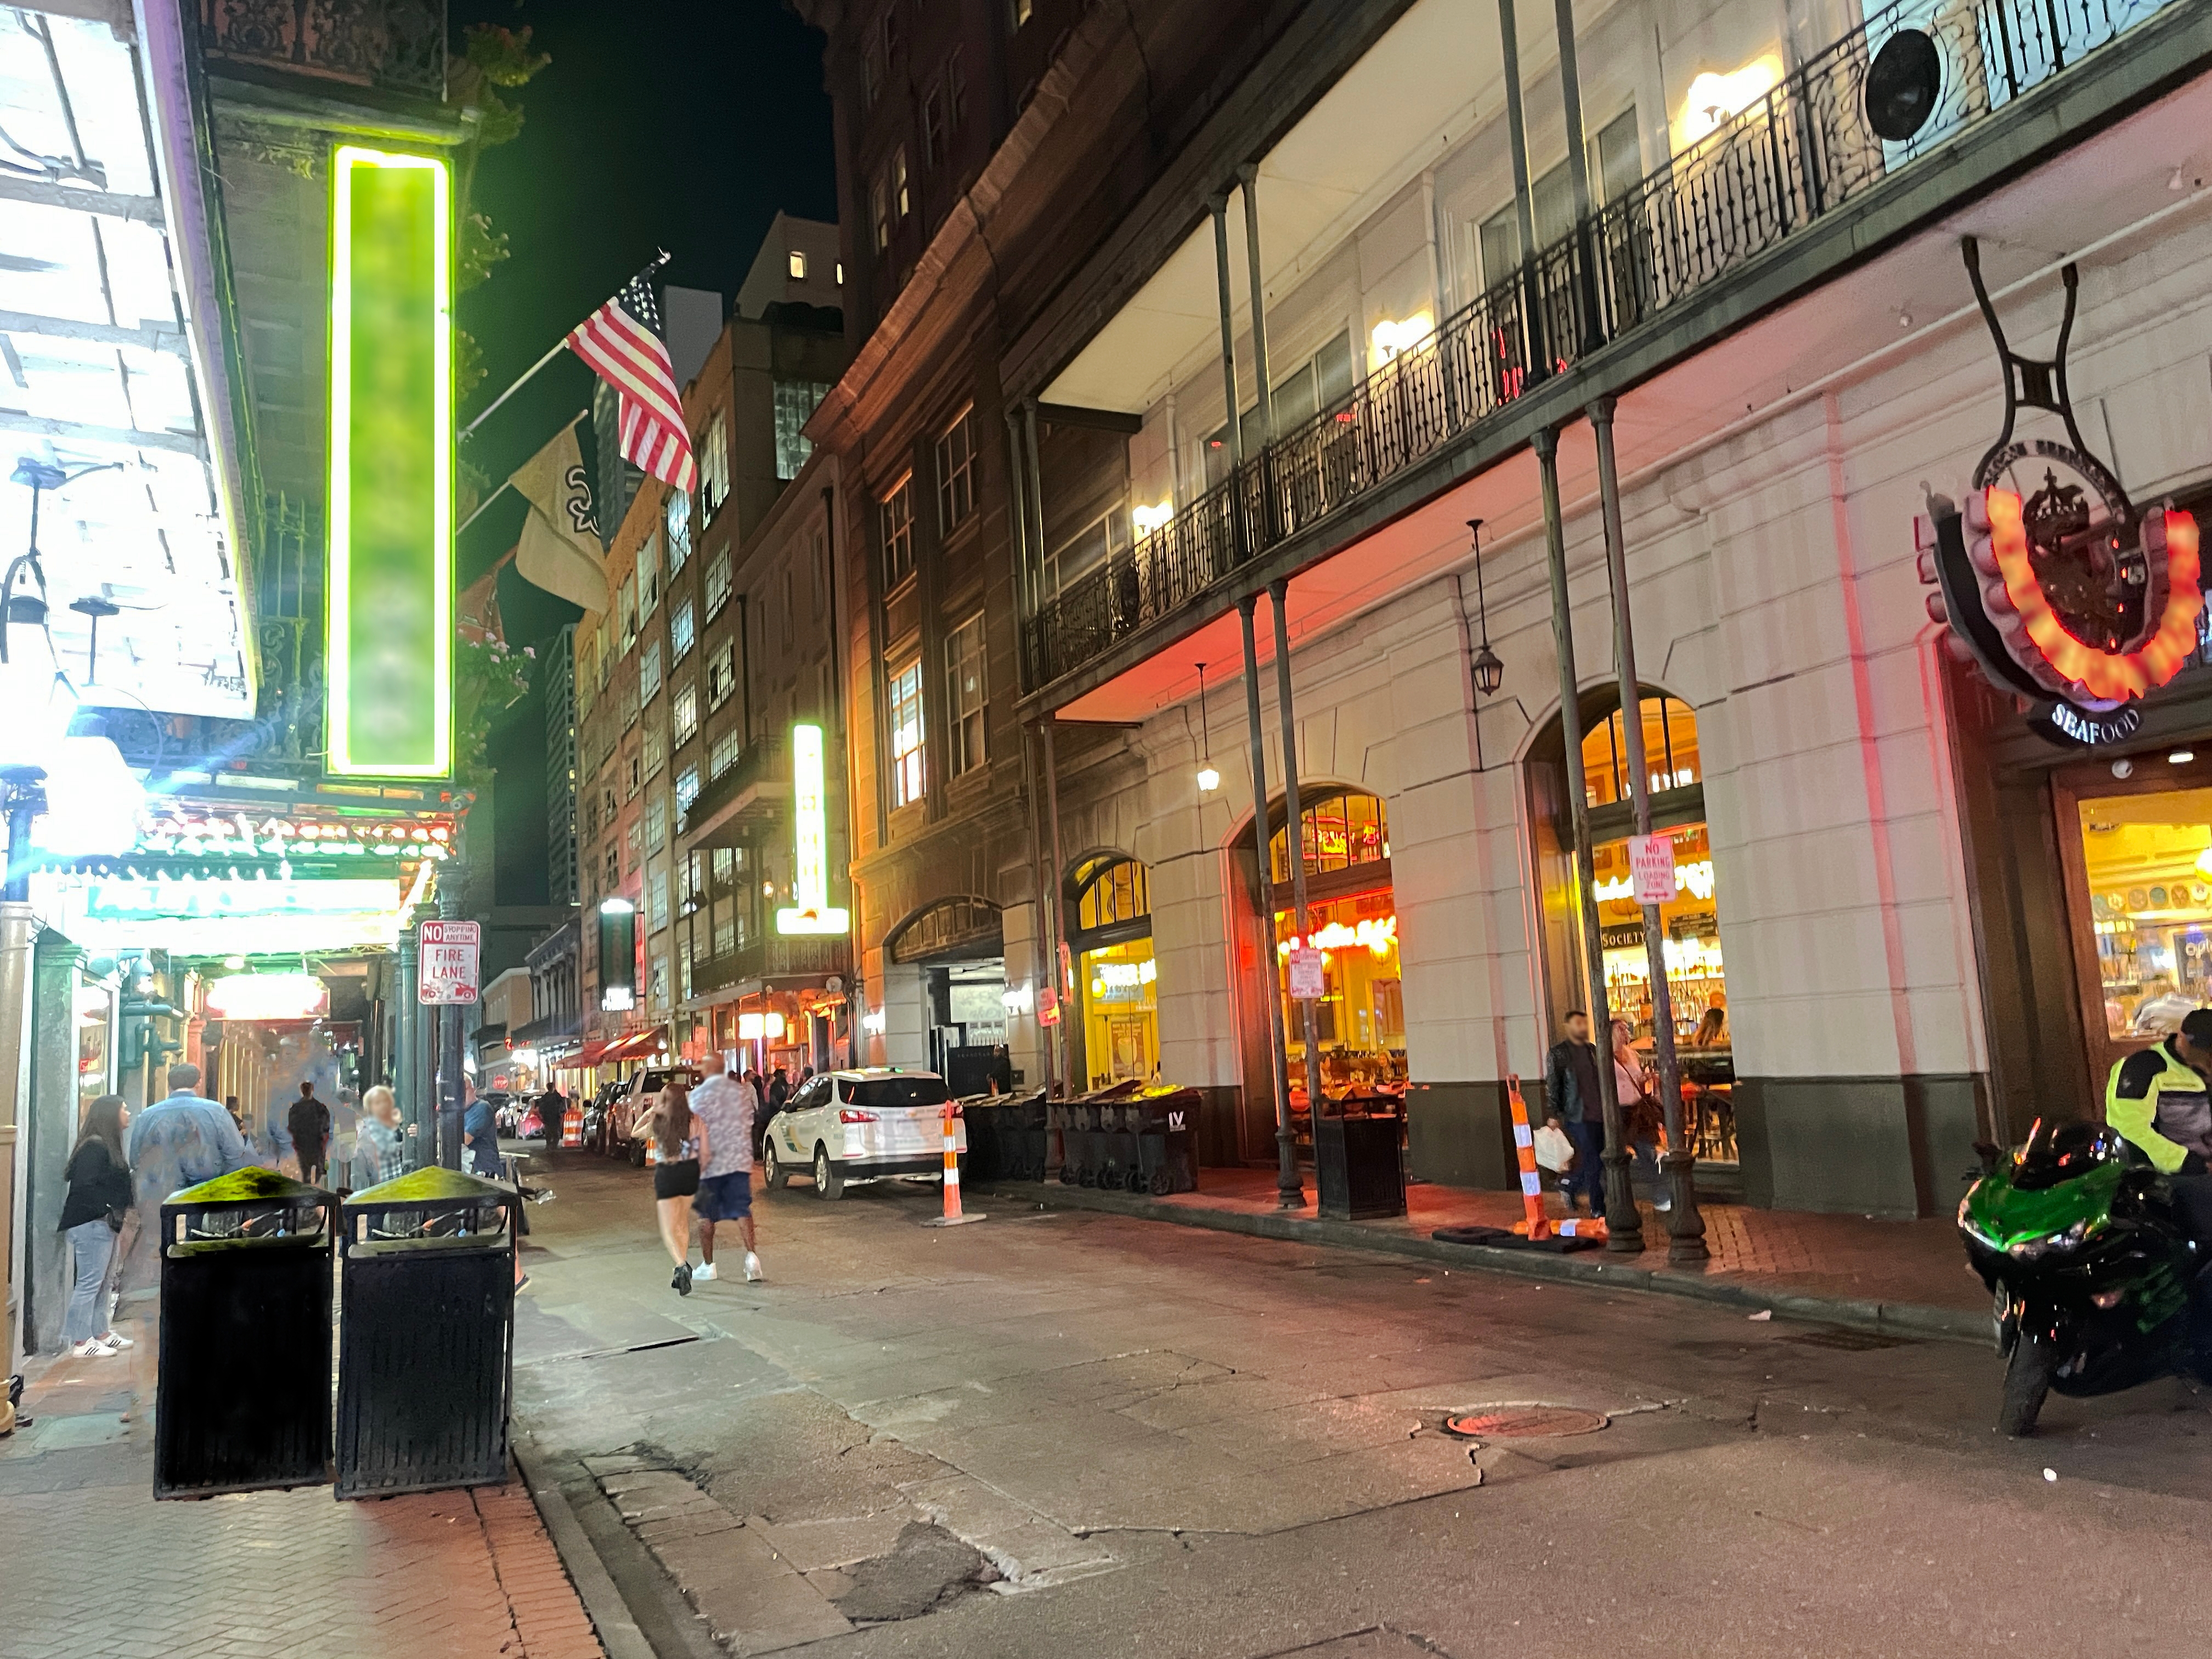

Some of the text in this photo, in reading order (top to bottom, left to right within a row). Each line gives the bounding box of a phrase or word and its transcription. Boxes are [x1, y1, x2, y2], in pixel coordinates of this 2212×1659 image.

[2051, 703, 2140, 744] SEAFOOD
[1645, 843, 1660, 855] NO
[1635, 857, 1671, 869] PARKING
[1638, 871, 1671, 881] LOADING
[424, 925, 477, 942] NO STOPPING
[1602, 931, 1645, 948] SOCIETY
[436, 949, 464, 962] FIRE
[1290, 952, 1300, 963] NO
[433, 967, 466, 979] LANE
